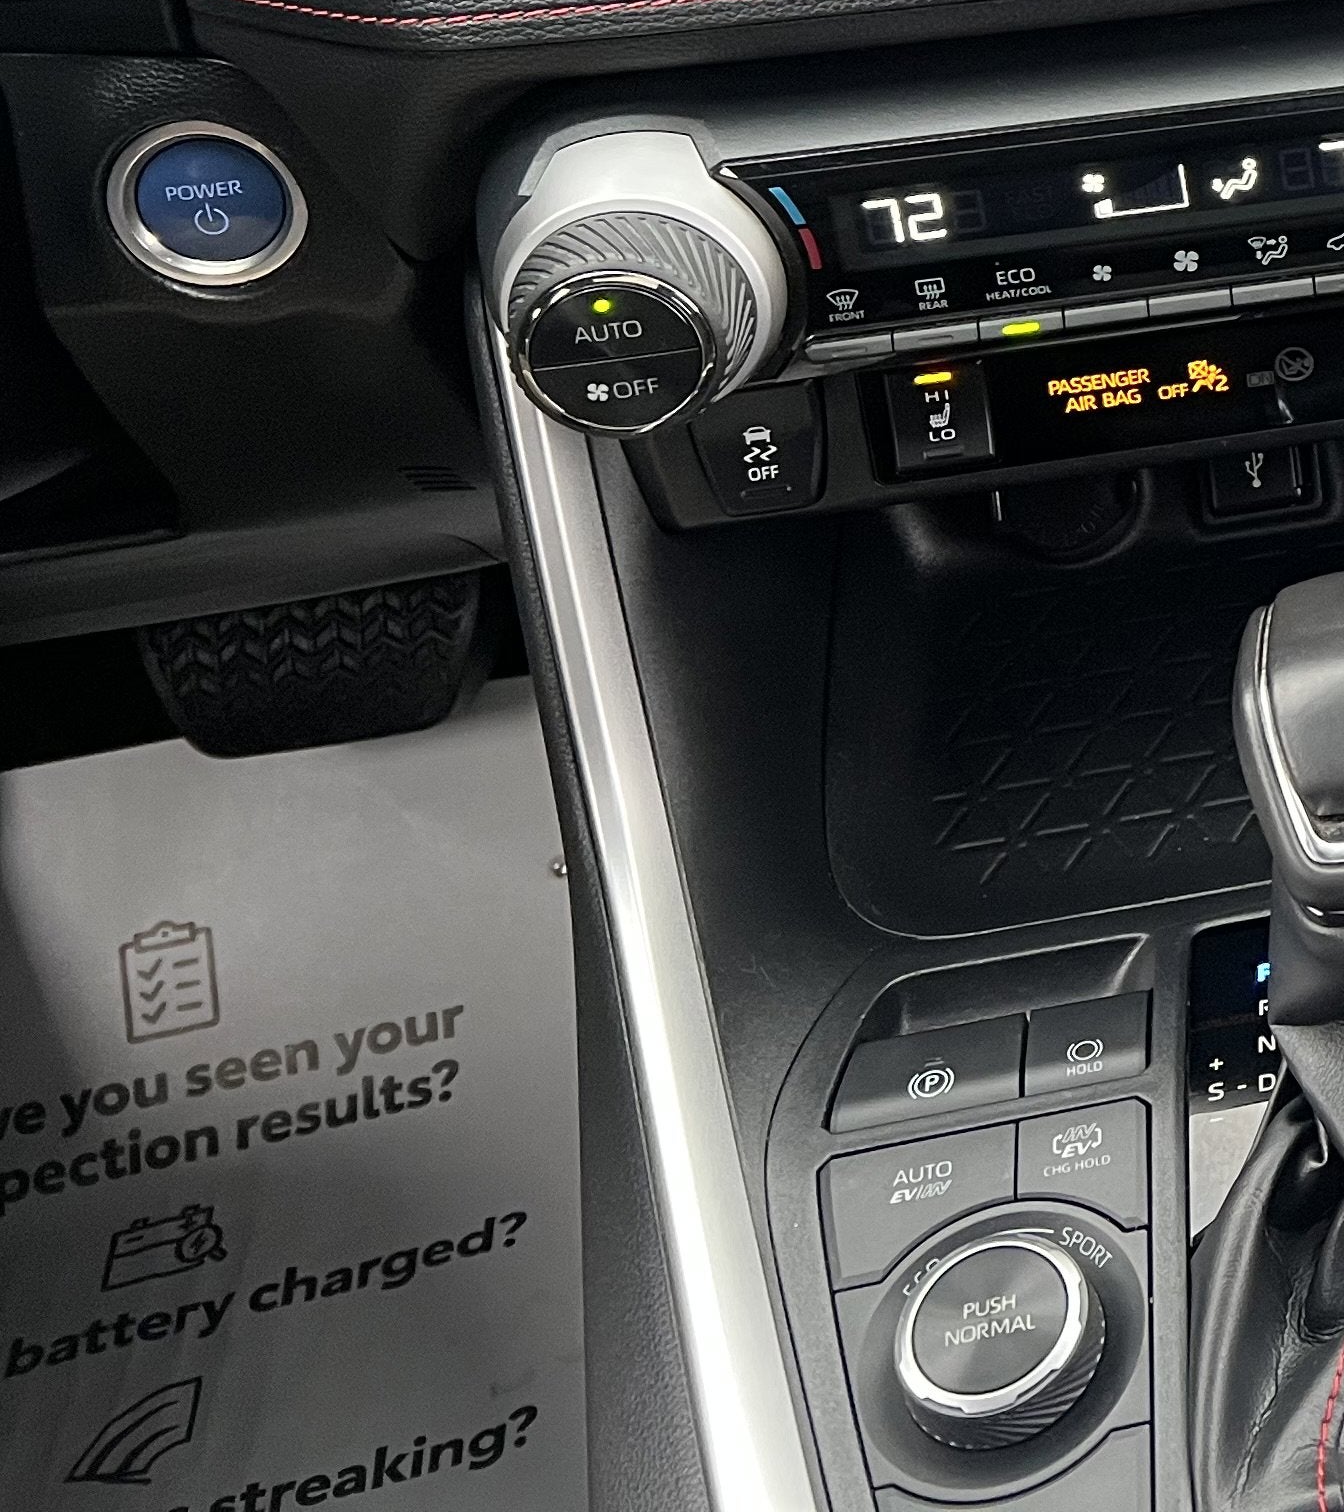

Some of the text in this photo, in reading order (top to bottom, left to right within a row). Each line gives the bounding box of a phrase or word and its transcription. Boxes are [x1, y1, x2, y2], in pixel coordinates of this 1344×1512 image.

[165, 179, 243, 202] POWER
[861, 192, 948, 244] 72
[995, 267, 1036, 285] ECO
[918, 298, 949, 311] REAR
[985, 285, 1052, 302] HEAT/COOL
[829, 307, 866, 323] FRONT
[574, 318, 643, 346] AUTO
[612, 376, 659, 400] OFF
[1047, 368, 1151, 396] PASSENGER
[1158, 383, 1190, 401] OFF
[925, 390, 950, 403] HI
[1065, 389, 1142, 414] AIR BAG
[929, 427, 956, 442] LO
[747, 464, 780, 483] OFF
[1257, 1035, 1276, 1054] N
[59, 1071, 170, 1137] you
[185, 1039, 320, 1097] seen
[334, 1004, 465, 1075] your
[1066, 1061, 1104, 1077] HOLD
[1207, 1081, 1225, 1102] S
[1258, 1073, 1277, 1093] D
[235, 1058, 460, 1152] results?
[893, 1160, 953, 1187] AUTO
[1043, 1154, 1111, 1177] CHG HOLD
[1058, 1226, 1113, 1268] SPORT
[4, 1210, 528, 1379] battery charged?
[962, 1292, 1018, 1320] PUSH
[943, 1313, 1037, 1347] NORMAL
